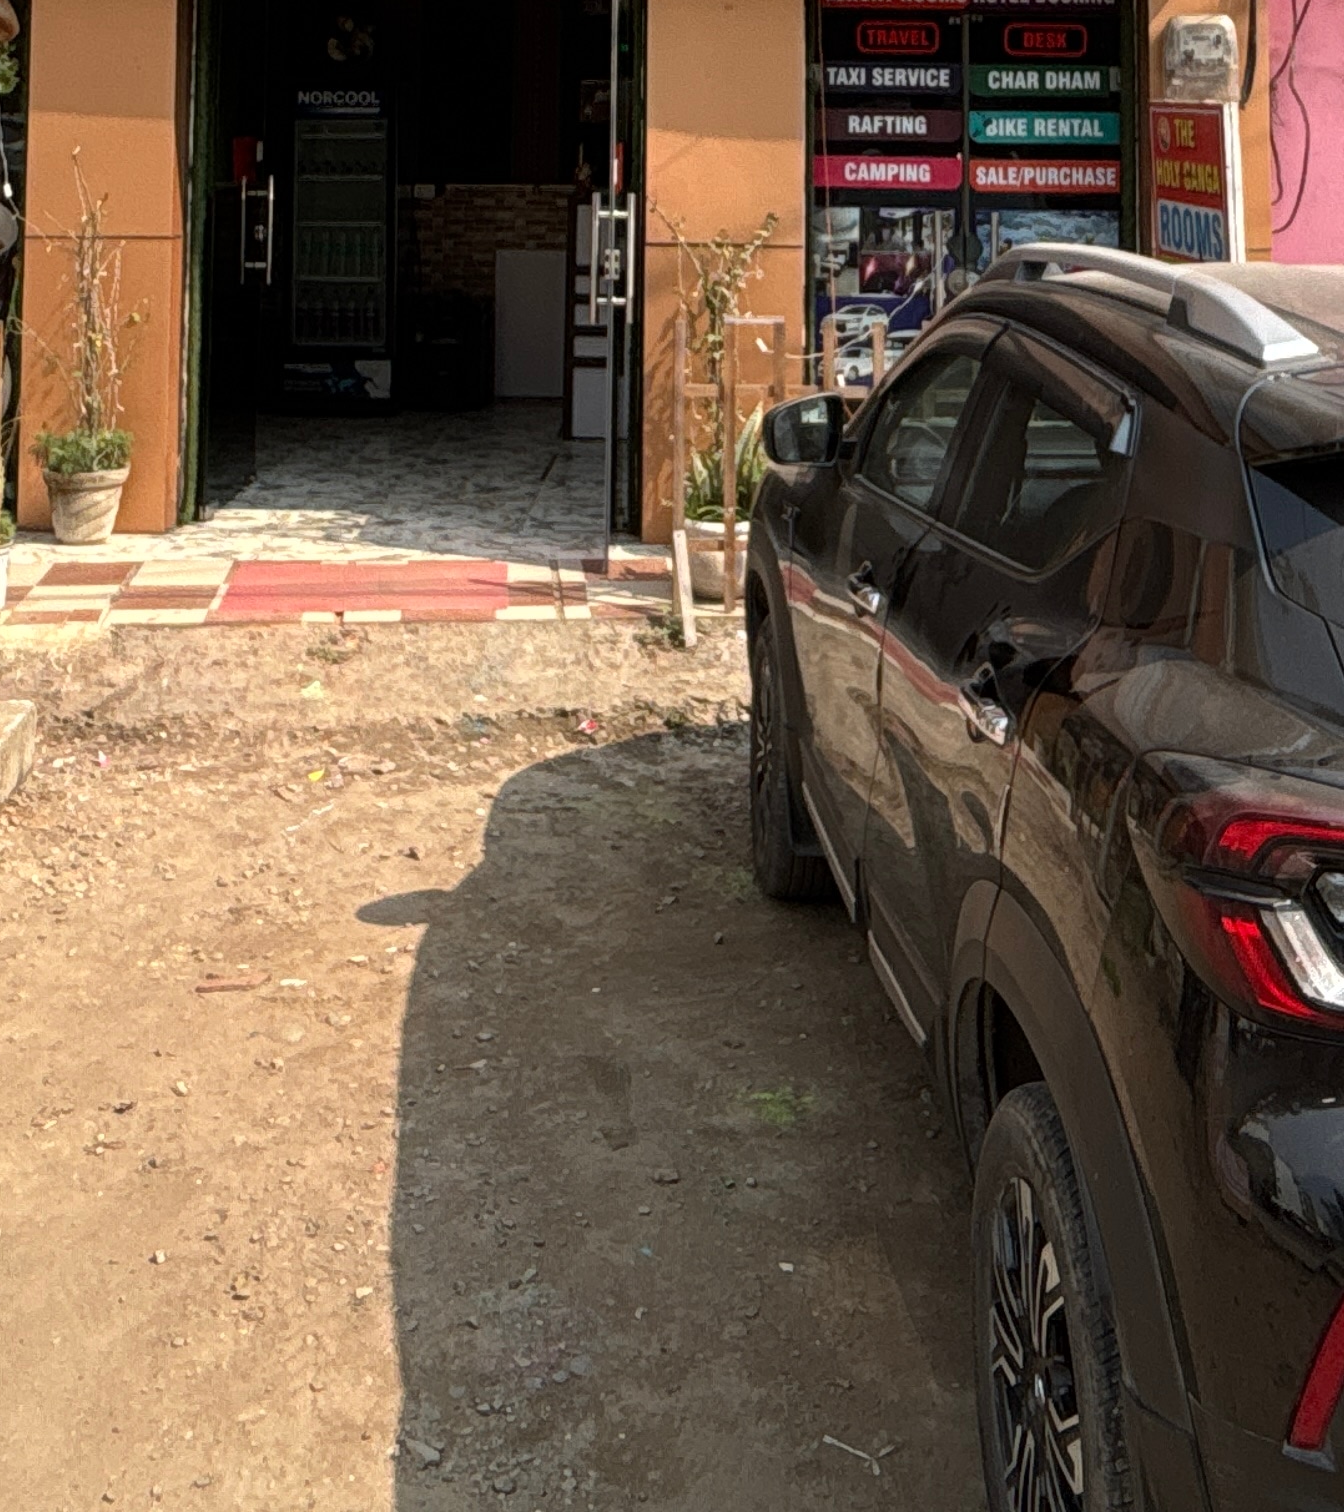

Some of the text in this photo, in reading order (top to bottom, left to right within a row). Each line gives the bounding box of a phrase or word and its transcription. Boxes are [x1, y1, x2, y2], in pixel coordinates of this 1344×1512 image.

[867, 29, 929, 46] TRAVEL
[827, 67, 950, 88] TAXI SERVICE
[988, 70, 1101, 91] CHAR DHAM
[298, 91, 380, 105] NORCOOL
[848, 115, 927, 135] RAFTING
[985, 118, 1104, 138] BIKE RENTAL
[1174, 118, 1196, 149] THE
[844, 162, 931, 183] CAMPING
[975, 166, 1116, 187] SALE/PURCHASE
[1157, 159, 1220, 195] HOLY GANGA
[1161, 202, 1224, 263] ROOMS
